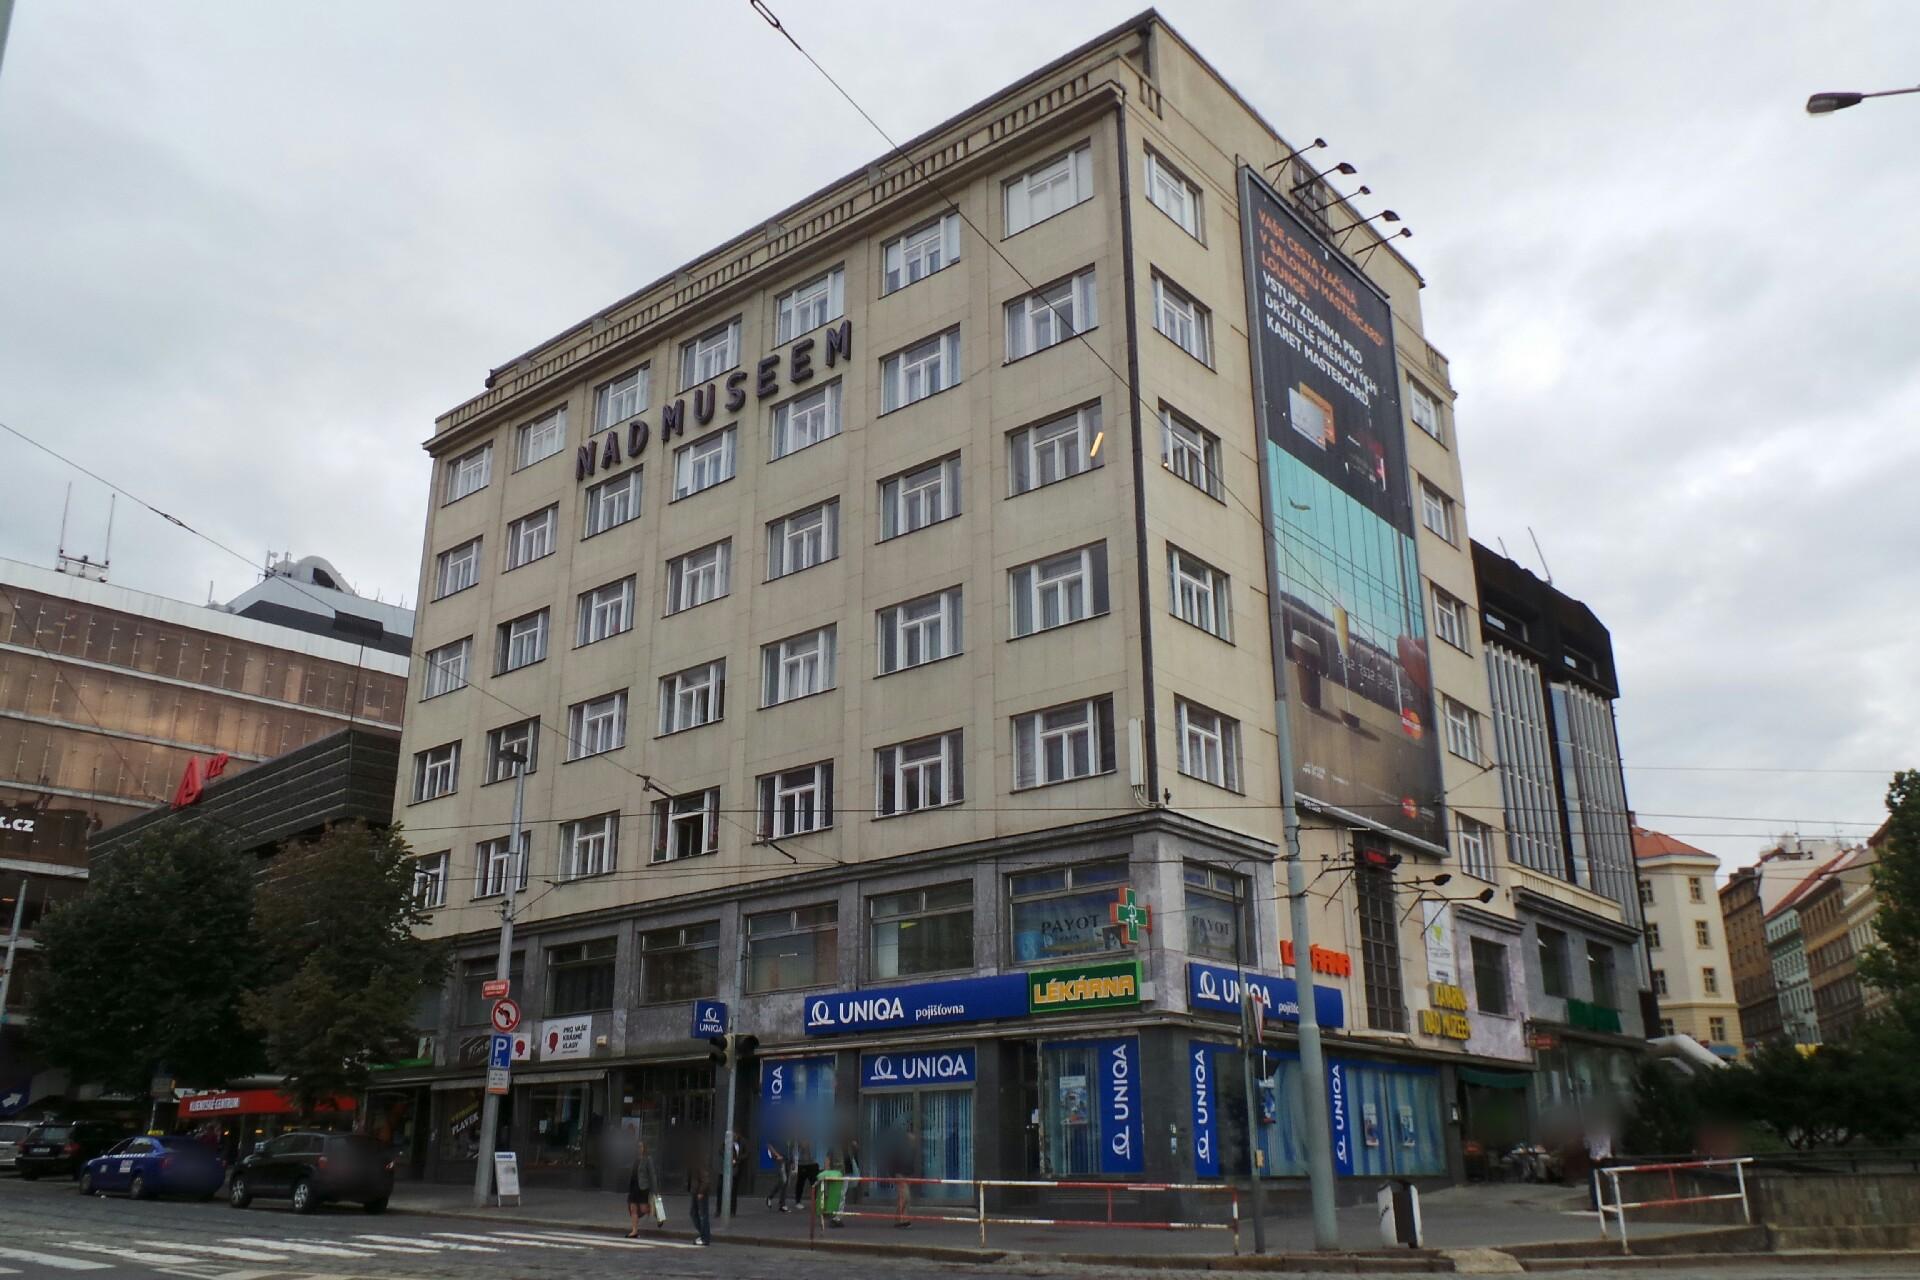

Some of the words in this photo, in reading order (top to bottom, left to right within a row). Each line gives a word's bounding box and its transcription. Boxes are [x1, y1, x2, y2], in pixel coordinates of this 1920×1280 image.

[1259, 208, 1284, 240] VAŠE
[1287, 236, 1319, 273] CESTA
[1270, 239, 1319, 290] SALONKU
[1263, 270, 1298, 308] VSTUP
[1299, 301, 1342, 348] ZDARMA
[1343, 339, 1363, 364] PRO
[1266, 313, 1301, 352] KARET
[1265, 292, 1315, 345] DRŽITELE
[1316, 335, 1377, 396] PRÉMIOVÝCH
[575, 420, 649, 481] NAD
[661, 320, 852, 442] MUSEEM
[1041, 915, 1099, 934] PAYOT
[1192, 915, 1229, 936] PAYOT
[839, 997, 904, 1024] UNIQA
[915, 1004, 964, 1021] pojišťovna
[1034, 975, 1135, 1004] LÉKÁRNA
[495, 1038, 507, 1057] P
[699, 1023, 724, 1034] UNIQA
[902, 1054, 968, 1079] UNIQA
[1112, 1044, 1129, 1120] UNIQA
[1194, 1049, 1208, 1124] UNIQA
[1332, 1064, 1344, 1130] UNIQA
